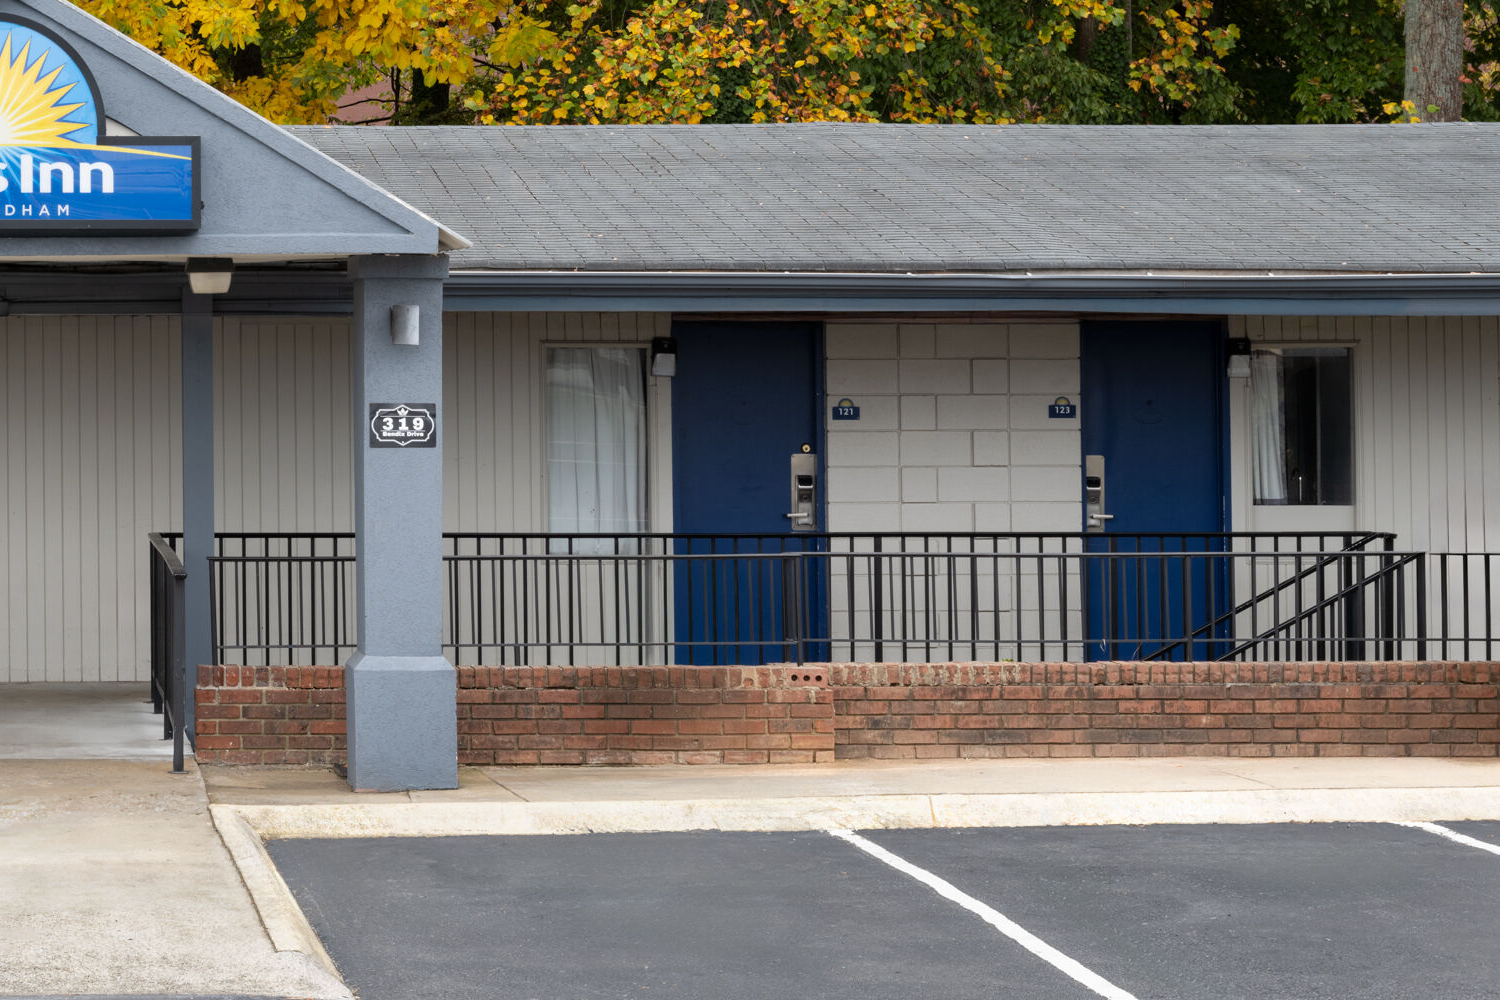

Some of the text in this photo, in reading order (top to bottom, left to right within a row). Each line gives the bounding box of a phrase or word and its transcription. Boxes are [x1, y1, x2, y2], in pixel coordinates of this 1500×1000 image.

[20, 154, 115, 193] Inn
[838, 407, 853, 415] 121
[1055, 406, 1070, 414] 123
[382, 417, 424, 431] 319
